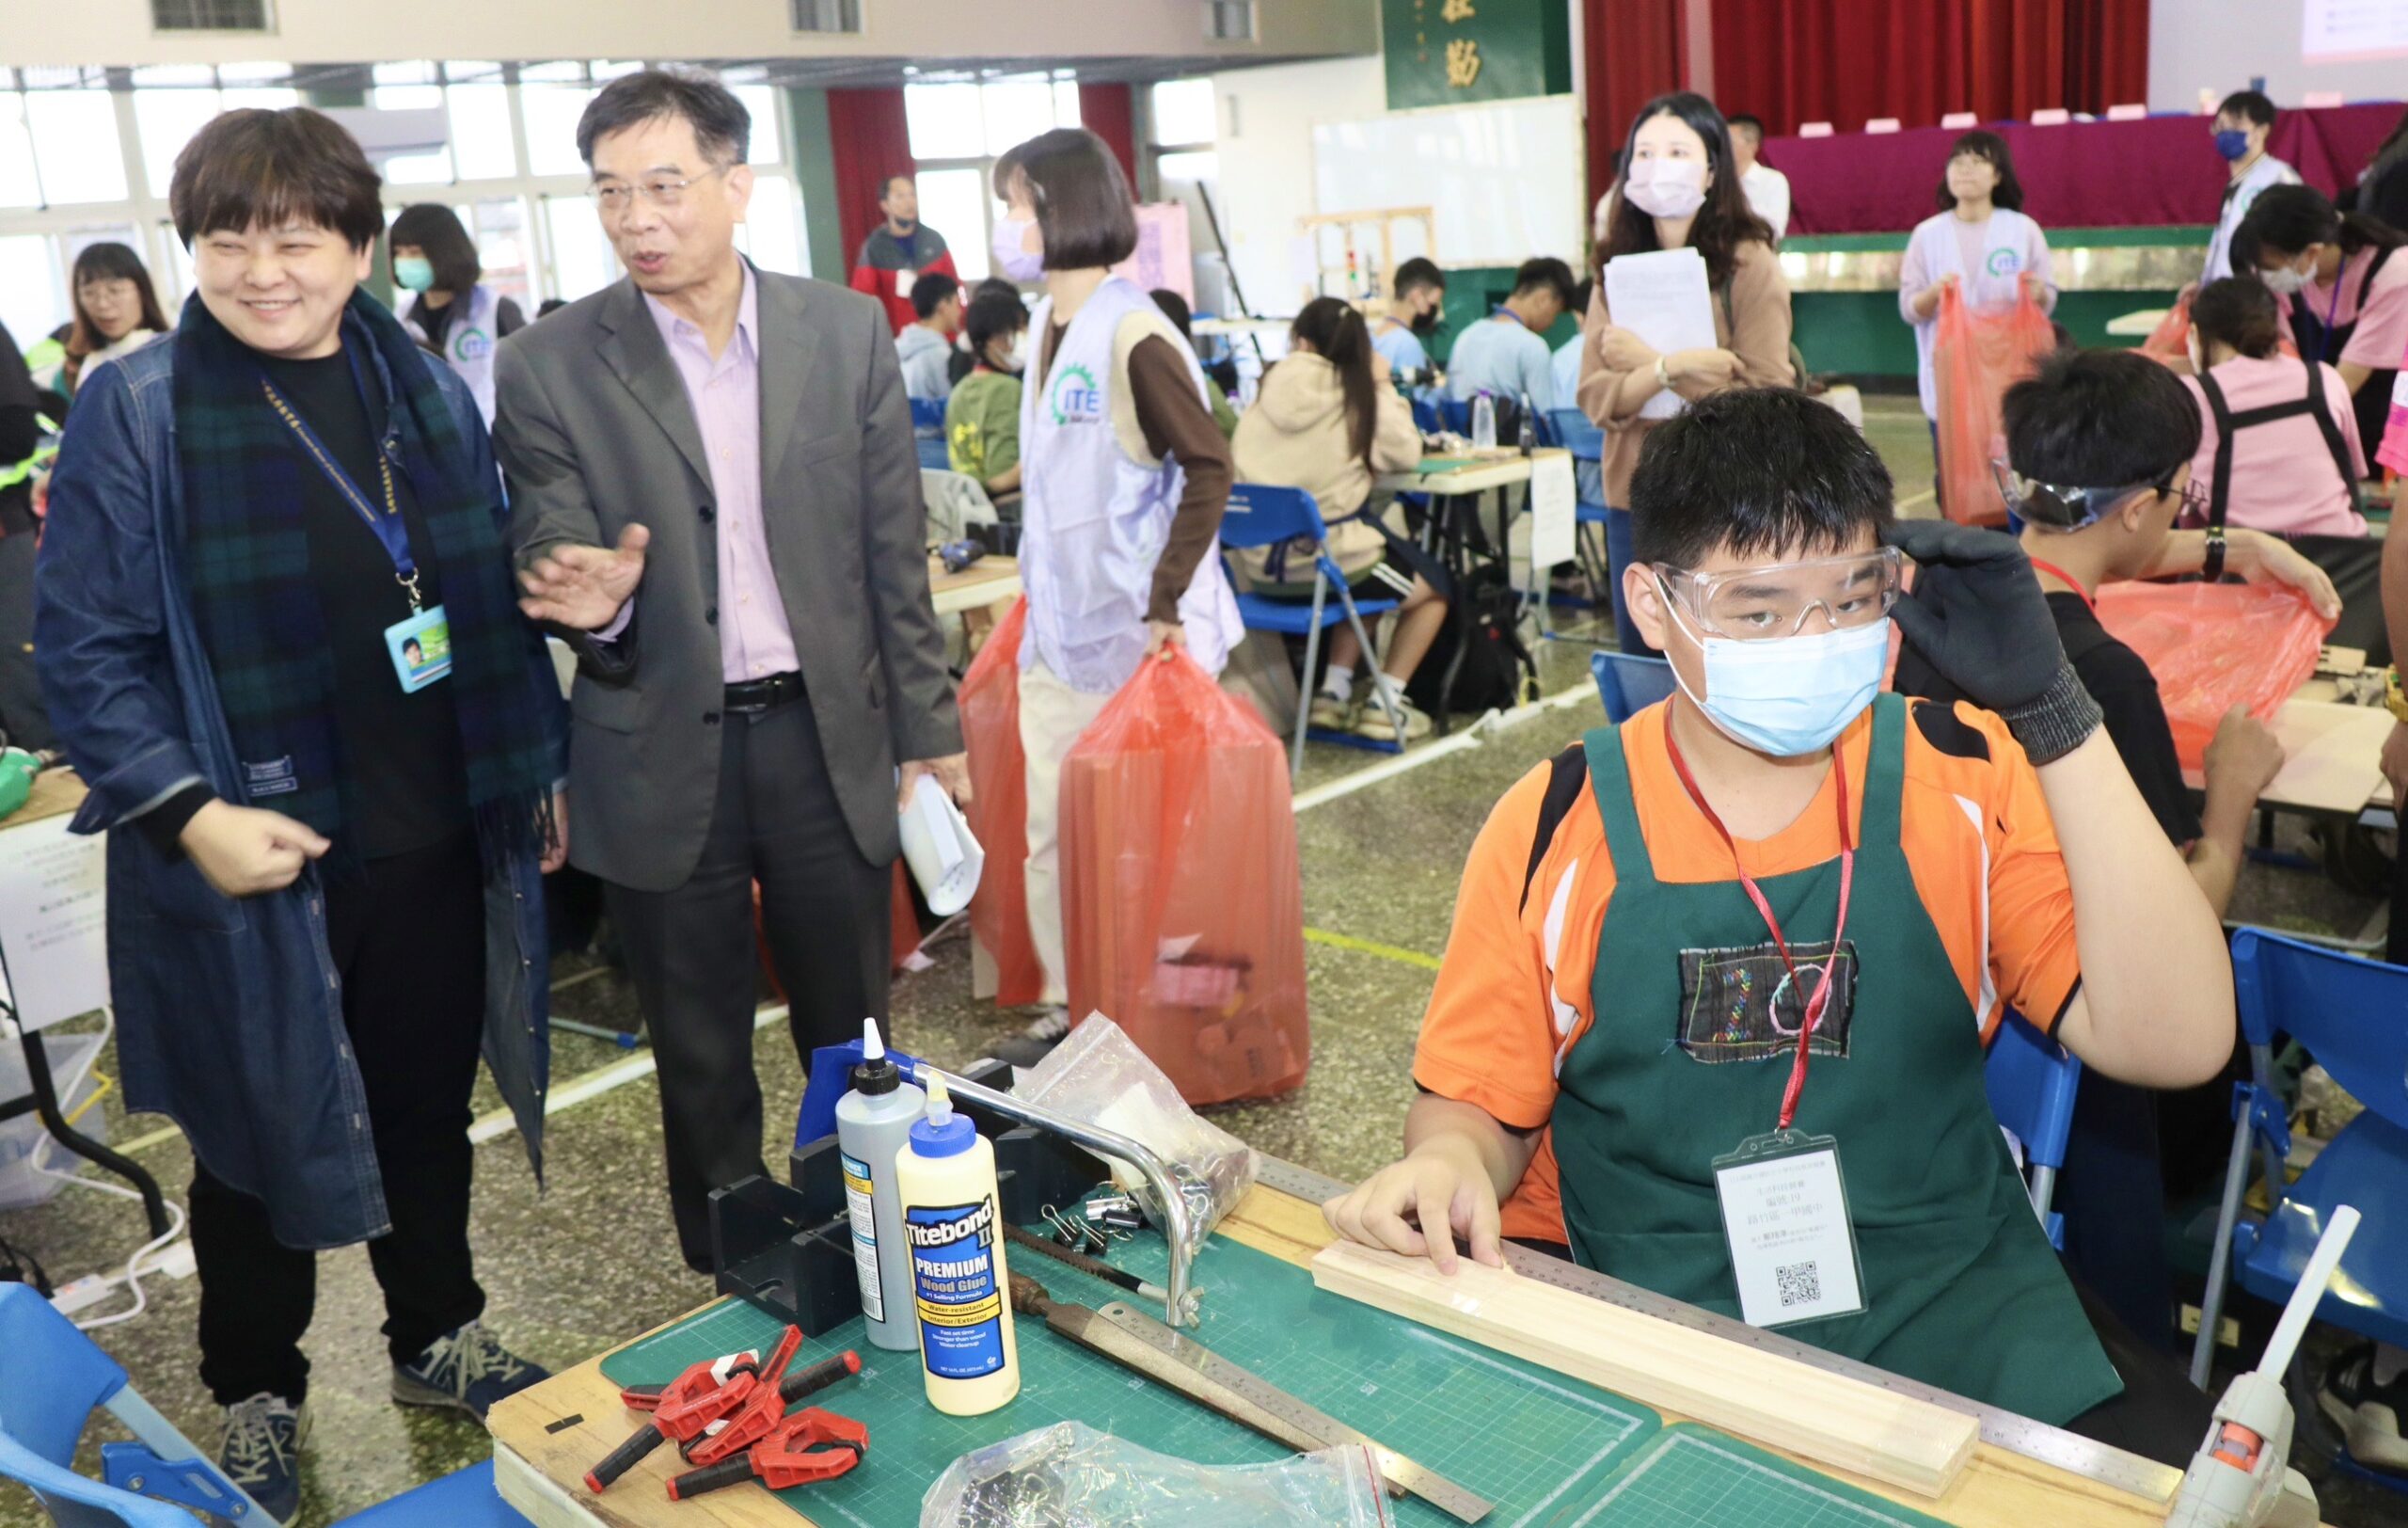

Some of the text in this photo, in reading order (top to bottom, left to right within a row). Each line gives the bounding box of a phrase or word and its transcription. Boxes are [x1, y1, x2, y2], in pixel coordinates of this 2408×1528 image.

[1065, 389, 1100, 412] ITE
[906, 1197, 992, 1246] Titebond
[915, 1253, 989, 1279] PREMIUM
[920, 1276, 988, 1293] Wood Glue
[956, 1290, 983, 1300] Formula
[928, 1303, 985, 1313] Water-resistant
[928, 1313, 988, 1325] Interior/Exterior
